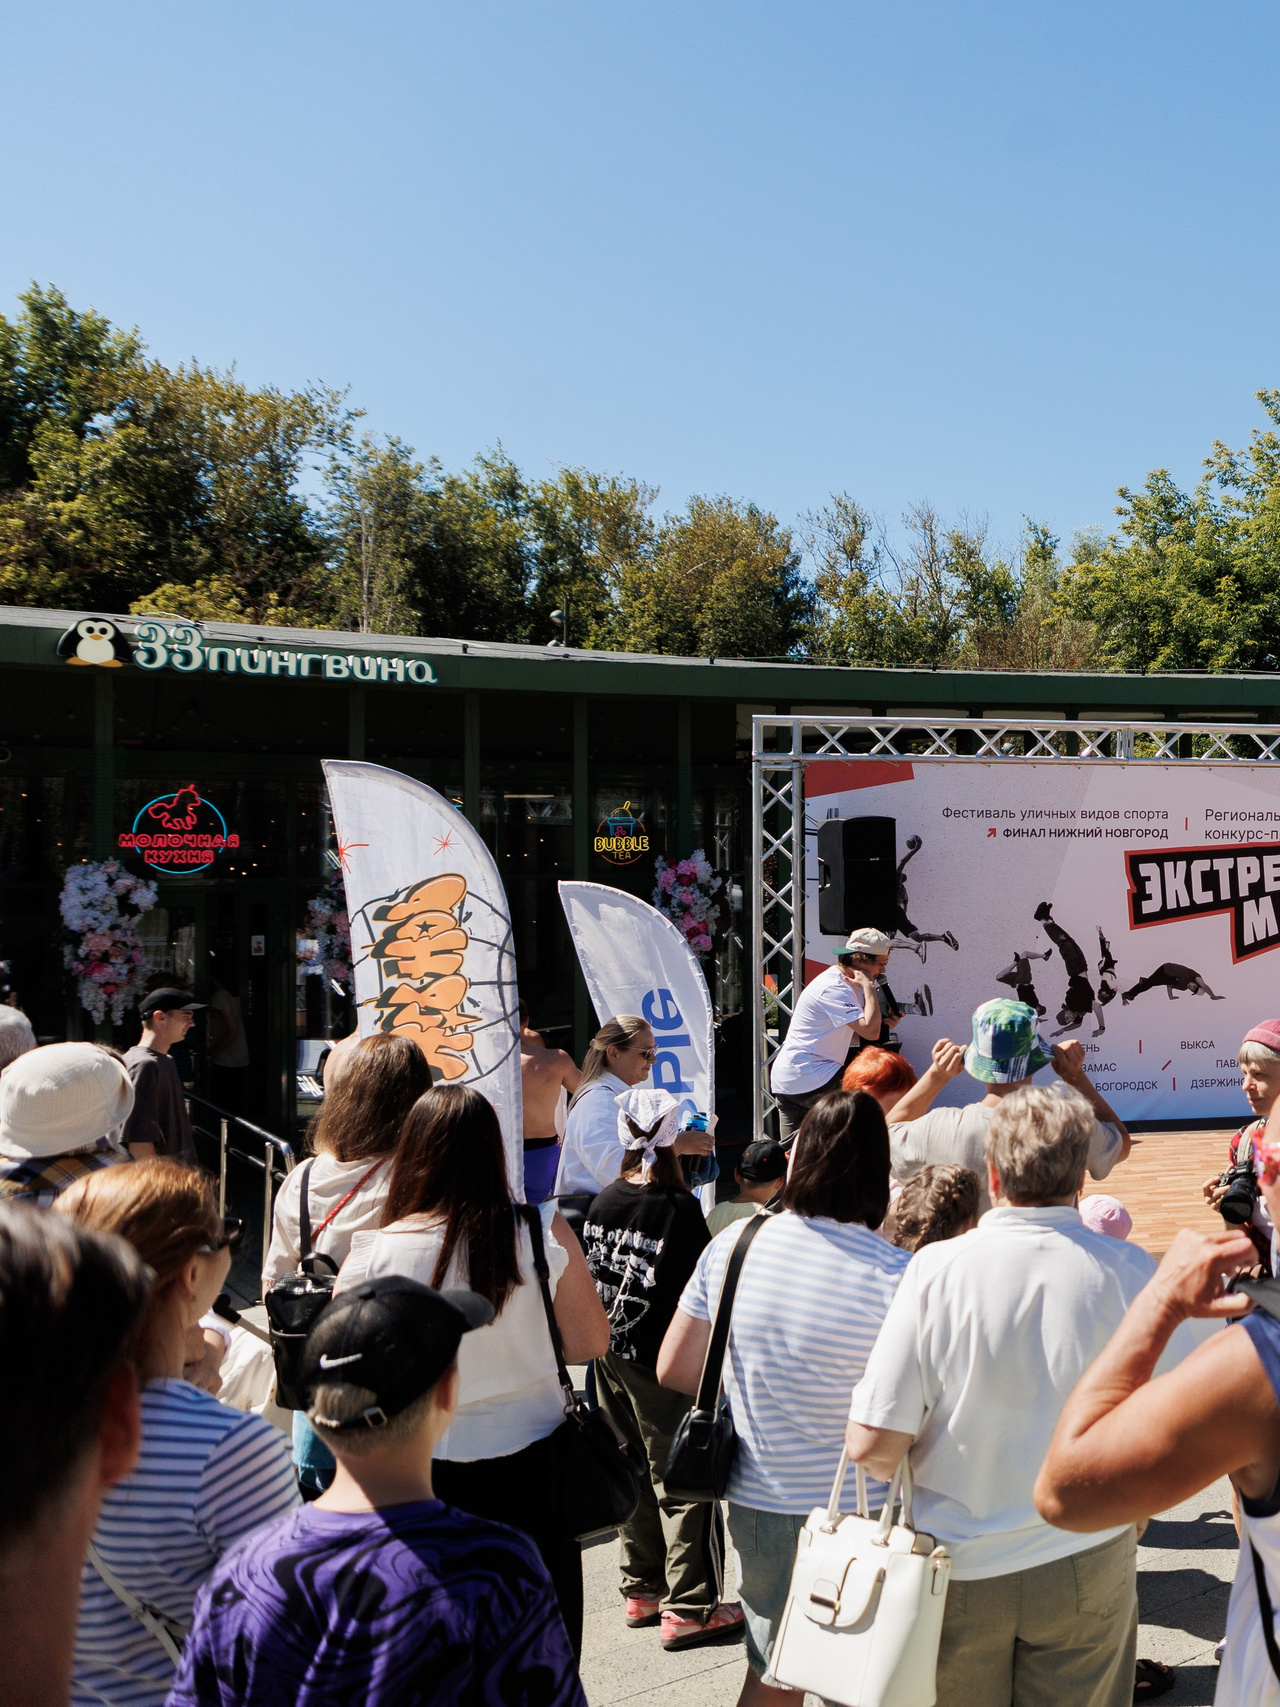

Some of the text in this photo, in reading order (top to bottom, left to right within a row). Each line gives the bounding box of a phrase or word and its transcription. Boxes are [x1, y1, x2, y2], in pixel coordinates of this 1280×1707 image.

[942, 806, 1169, 823] Фестиваль уличных видов спорта
[1003, 826, 1169, 840] ФИНАЛ НИЖНИЙ НОВГОРОД
[118, 833, 240, 848] МОЛОЧНАЯ
[594, 836, 650, 852] BUBBLE
[144, 849, 215, 864] КУХНЯ
[611, 851, 632, 860] TEA
[1180, 1040, 1216, 1050] ВЫКСА
[1081, 1062, 1117, 1073] ЗАМАС
